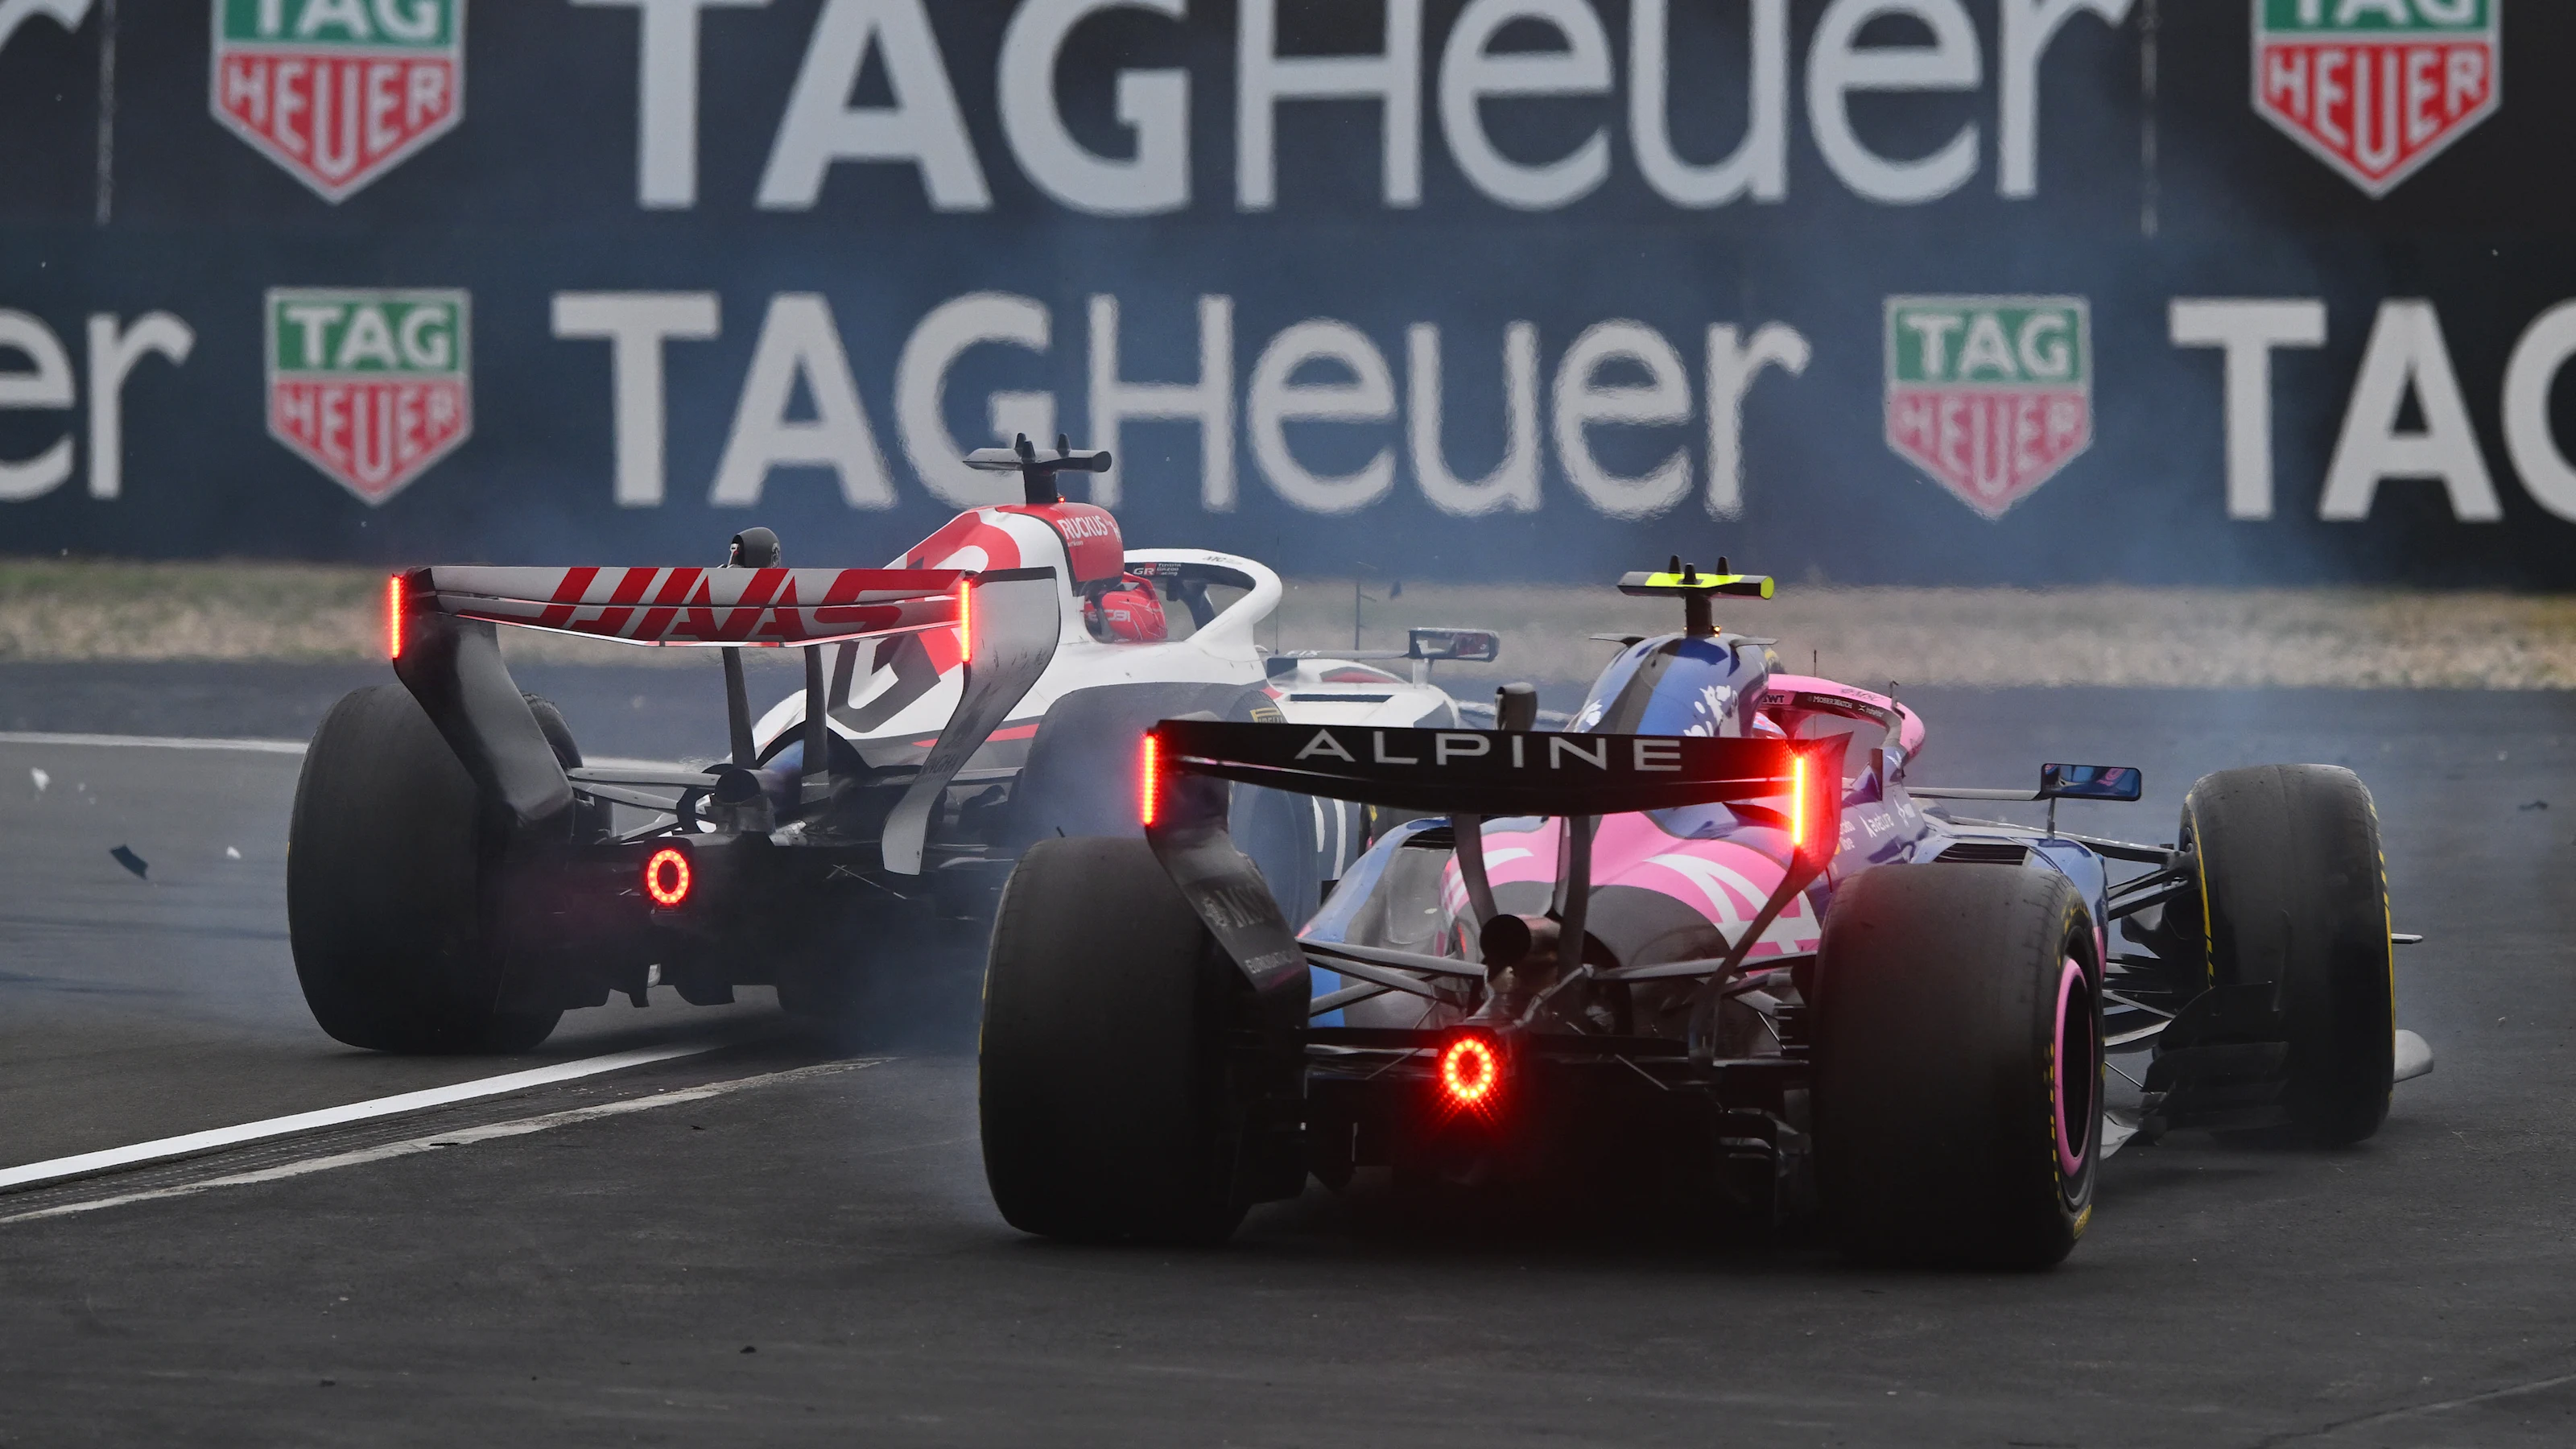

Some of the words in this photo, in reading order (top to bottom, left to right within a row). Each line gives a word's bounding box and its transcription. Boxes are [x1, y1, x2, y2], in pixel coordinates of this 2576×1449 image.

[226, 60, 449, 175] HEUER
[2268, 49, 2485, 164] HEUER
[284, 307, 448, 368] TAG
[1902, 315, 2069, 379] TAG
[279, 384, 458, 482] HEUER
[1901, 394, 2079, 493] HEUER
[1057, 515, 1108, 539] RUCKUS
[459, 567, 962, 642] HAAS
[1294, 729, 1682, 771] ALPINE
